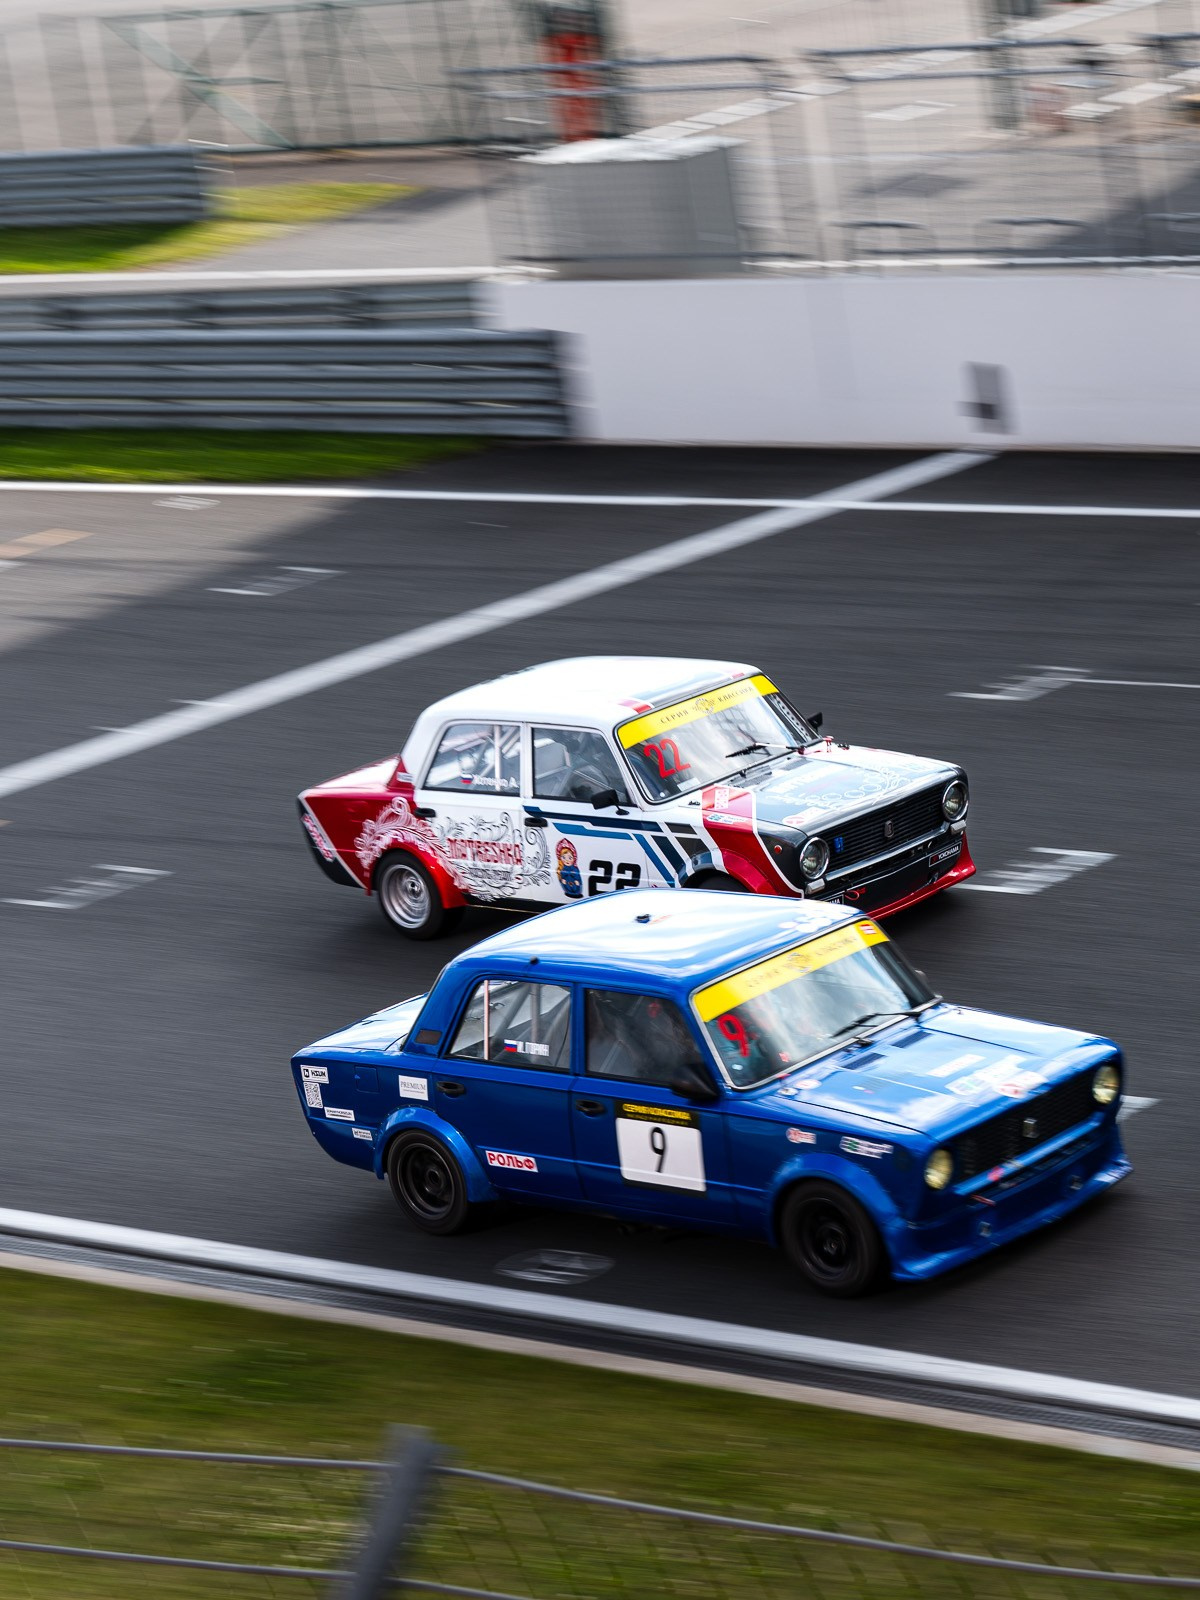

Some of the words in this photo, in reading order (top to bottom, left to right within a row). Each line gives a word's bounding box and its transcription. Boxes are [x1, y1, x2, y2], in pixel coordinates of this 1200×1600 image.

[643, 738, 692, 779] 22
[938, 845, 960, 860] YOKOHAMA
[588, 859, 641, 897] 22
[717, 1013, 750, 1057] 9
[487, 1152, 535, 1170] РОЛЬФ
[649, 1125, 667, 1174] 9
